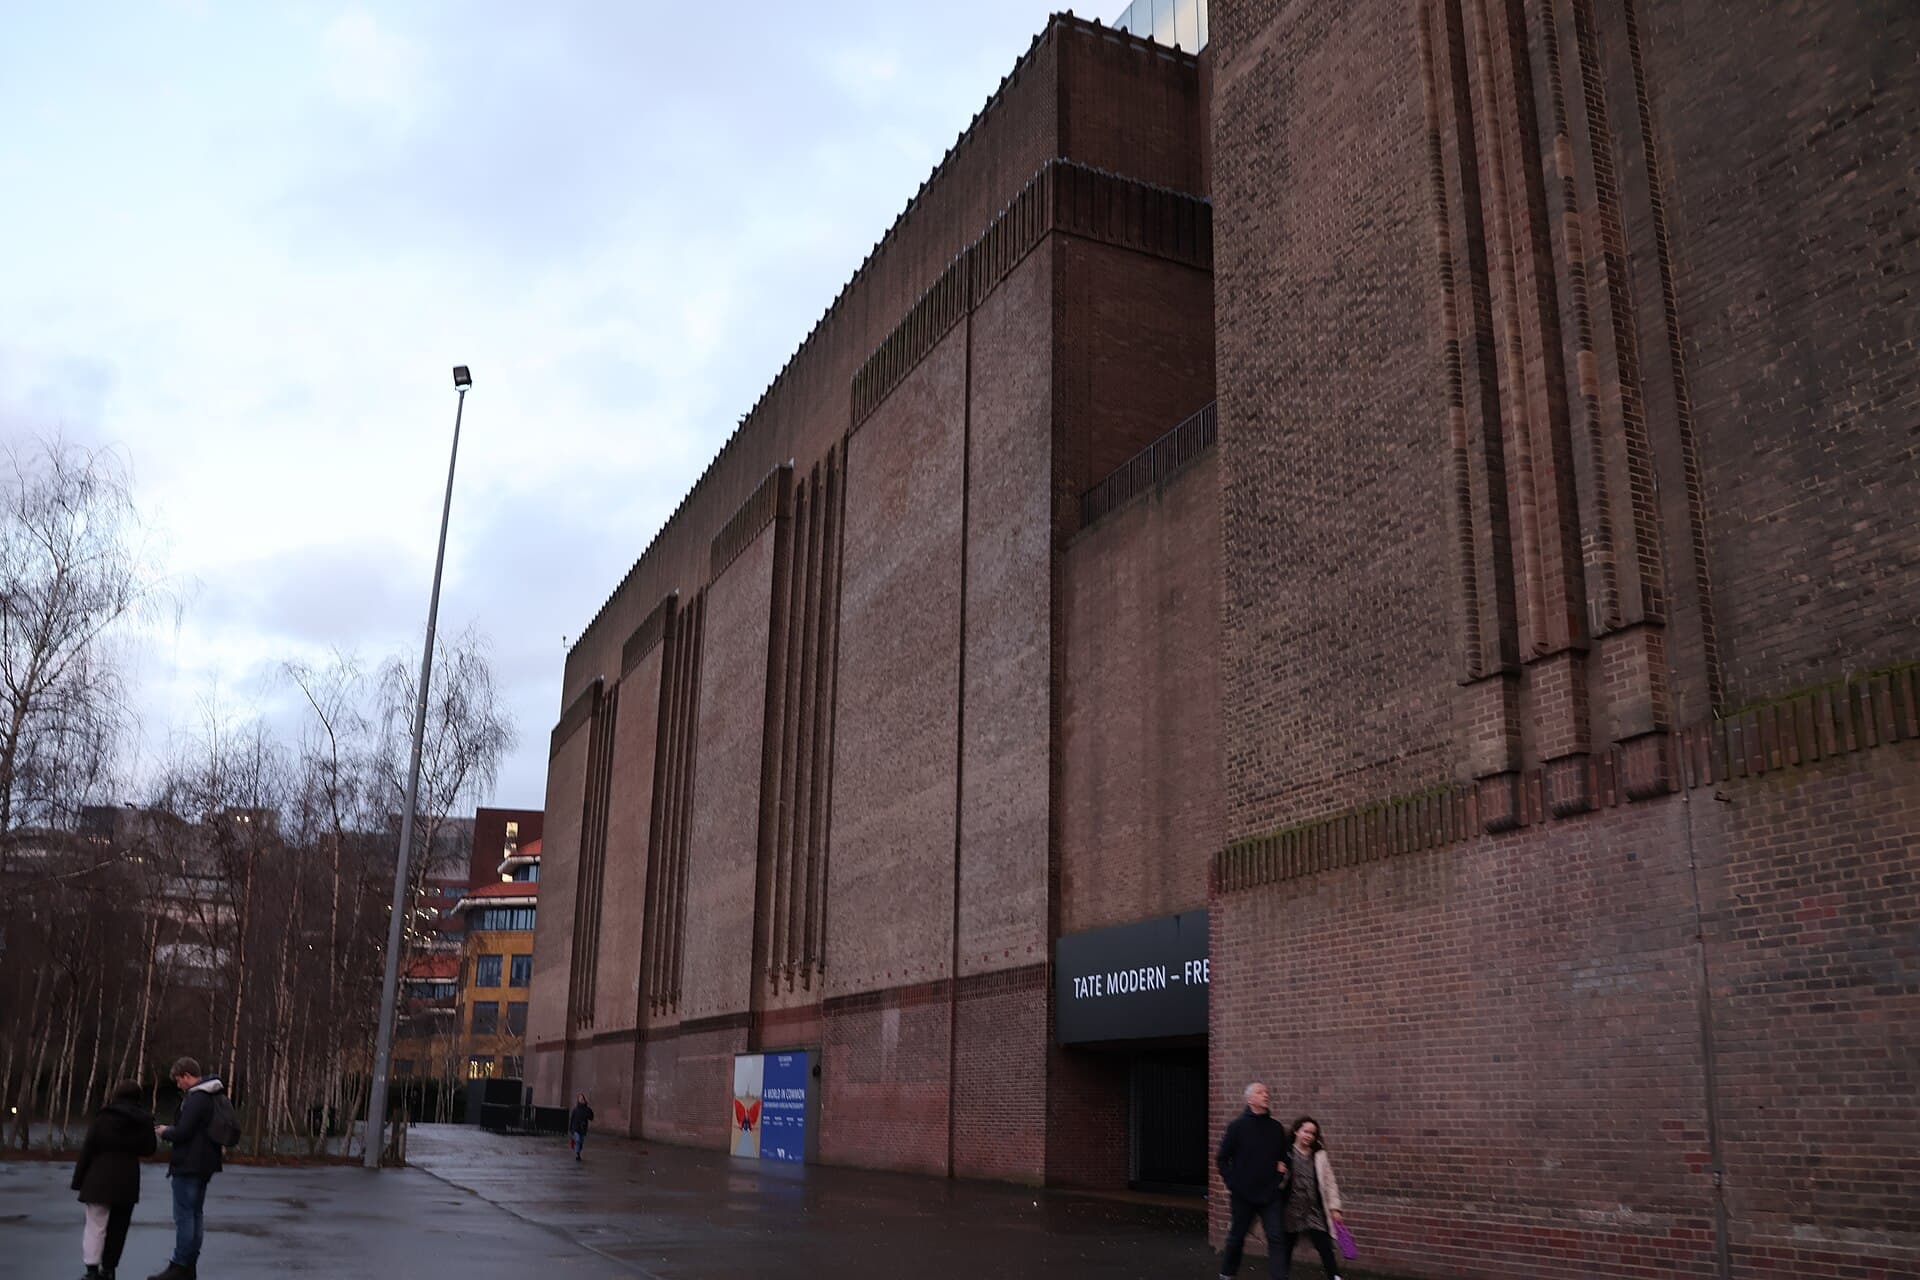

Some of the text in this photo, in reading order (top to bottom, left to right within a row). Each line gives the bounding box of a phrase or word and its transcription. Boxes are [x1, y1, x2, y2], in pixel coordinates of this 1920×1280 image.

[1073, 974, 1102, 999] TATE
[1106, 965, 1167, 995] MODERN
[764, 1088, 768, 1098] A
[768, 1088, 780, 1099] WORLD
[786, 1088, 805, 1100] COMMON
